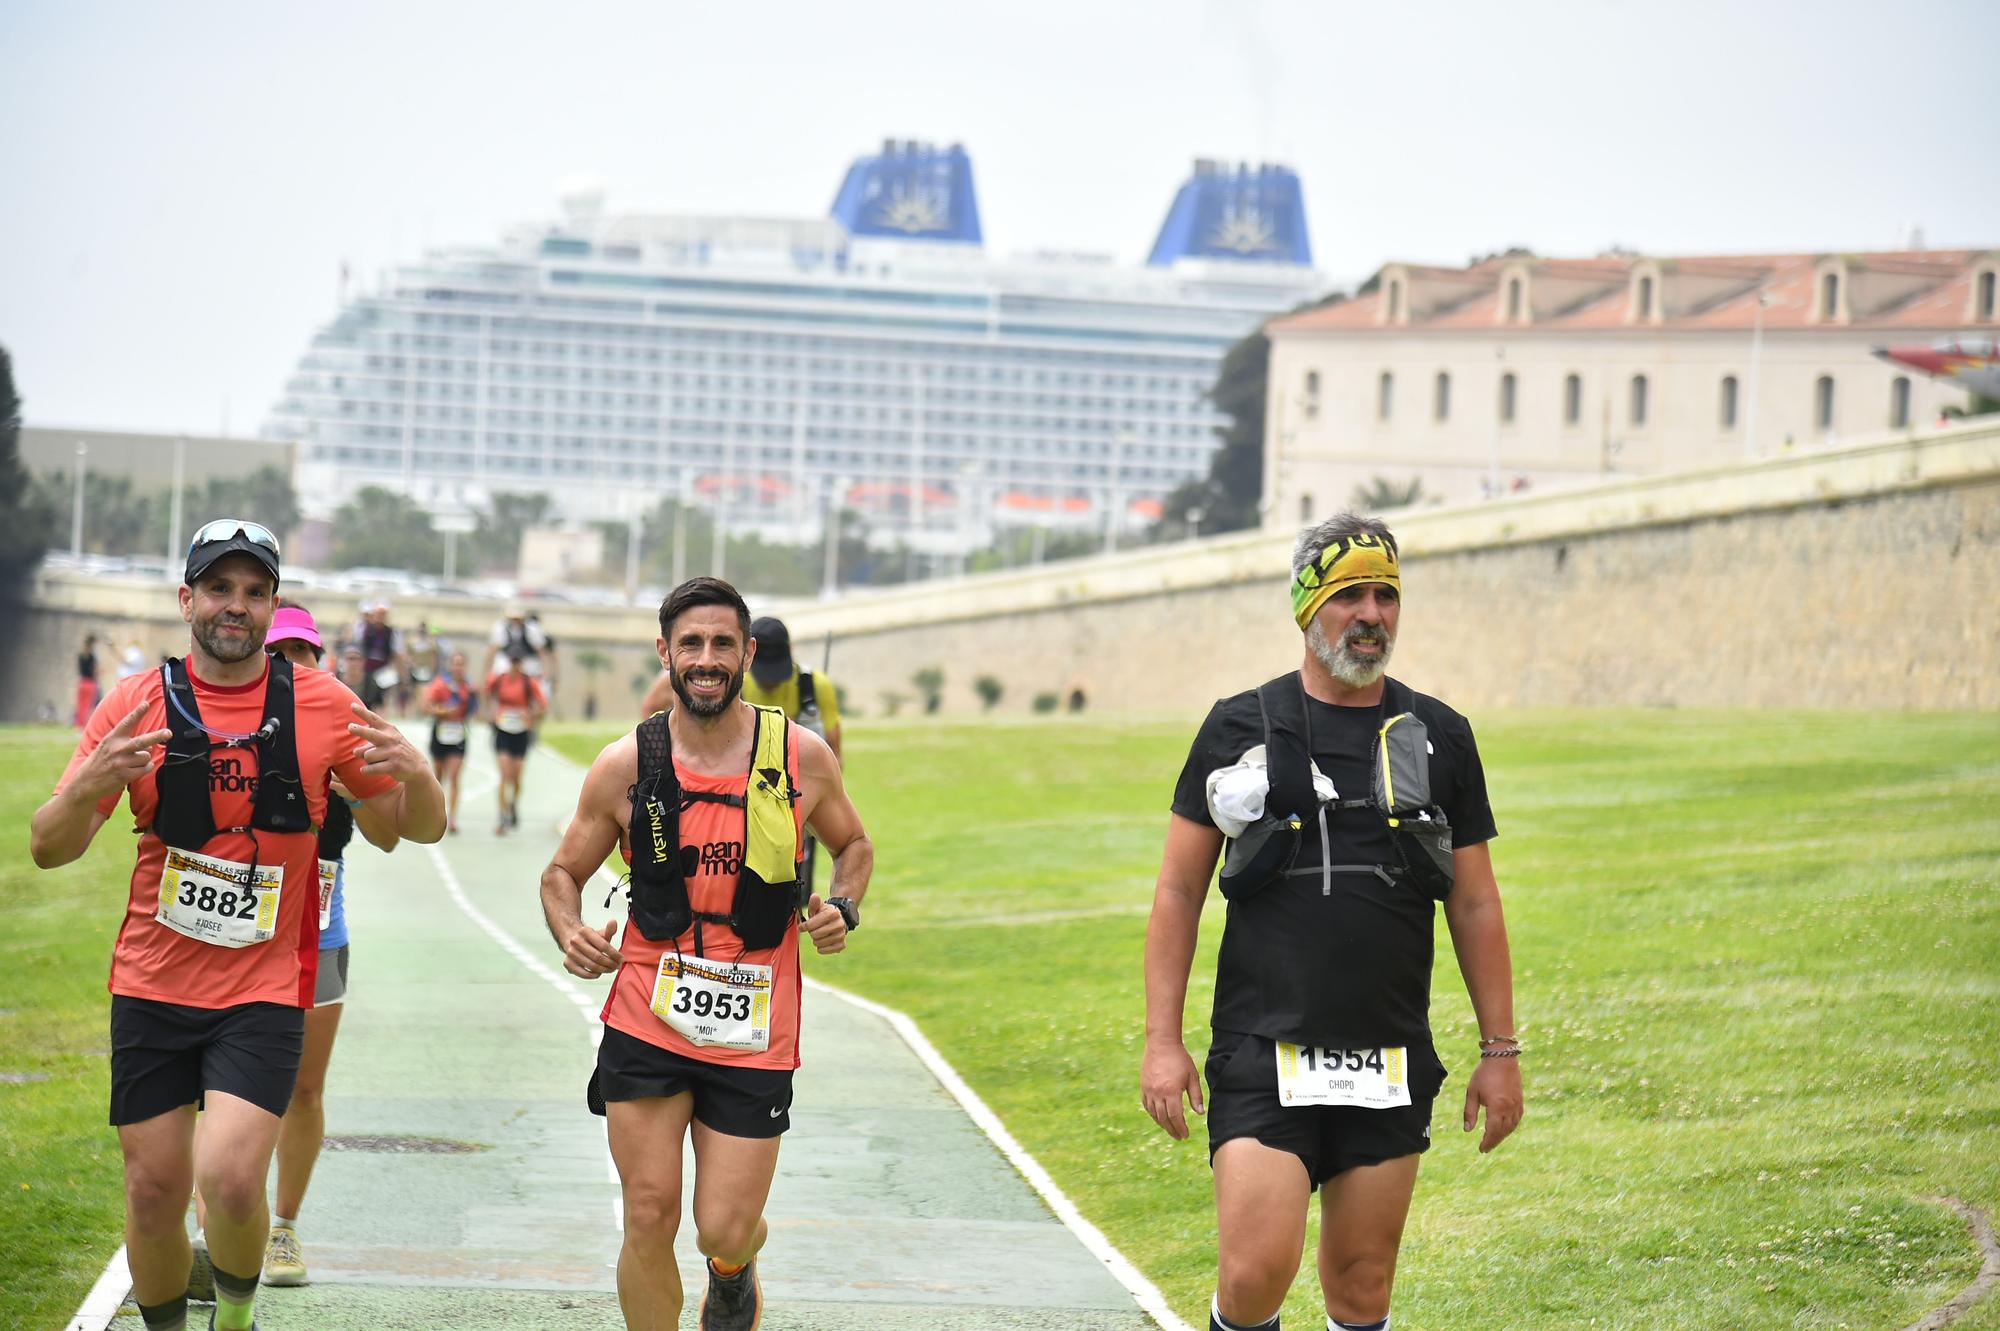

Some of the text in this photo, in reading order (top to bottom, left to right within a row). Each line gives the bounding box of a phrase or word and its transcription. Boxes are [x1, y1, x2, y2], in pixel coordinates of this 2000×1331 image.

[208, 758, 241, 776] an
[702, 841, 742, 865] pan
[705, 858, 741, 876] mo
[234, 873, 263, 885] 203
[178, 880, 258, 920] 3882
[728, 973, 755, 985] 2023
[673, 986, 751, 1021] 3953
[1300, 1046, 1385, 1075] 1554
[1329, 1080, 1355, 1090] CHOPO
